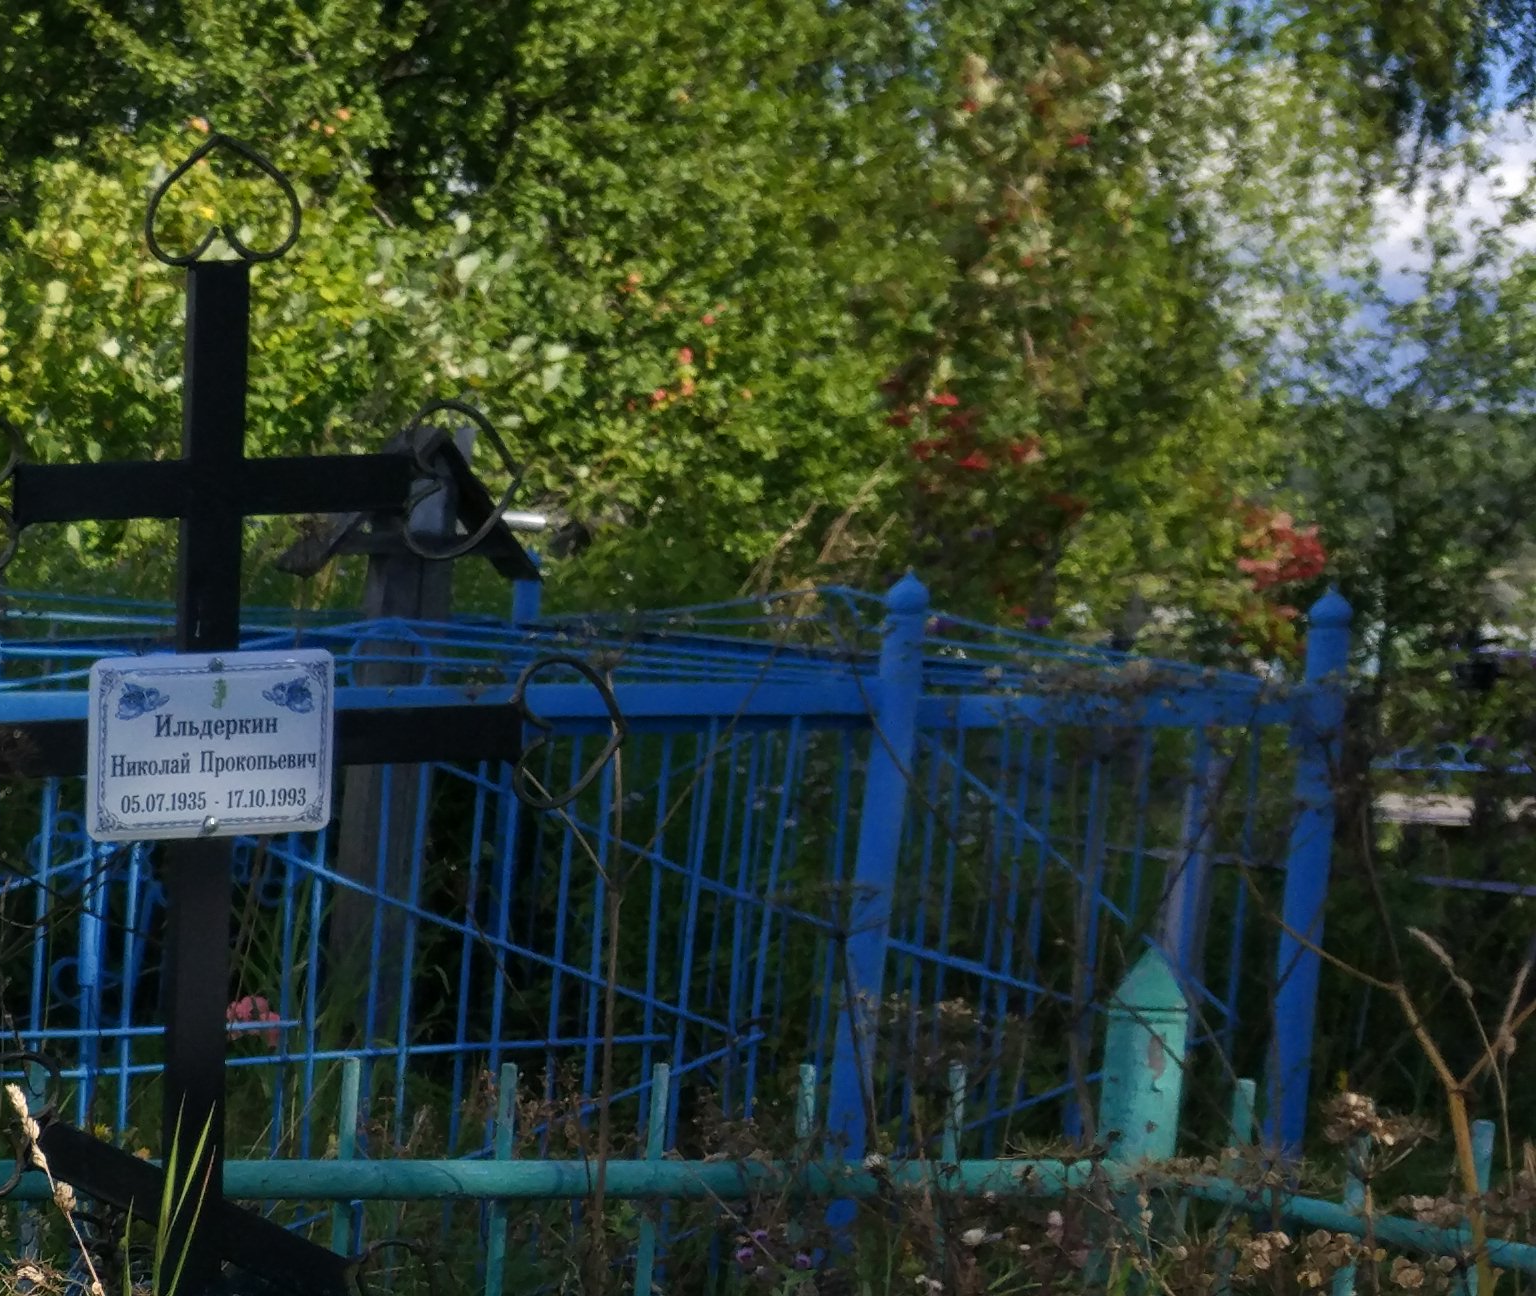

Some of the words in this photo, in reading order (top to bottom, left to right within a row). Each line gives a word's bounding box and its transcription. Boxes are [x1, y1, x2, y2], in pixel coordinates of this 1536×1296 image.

[154, 713, 279, 740] Ильдеркин
[110, 752, 191, 777] Николай
[199, 750, 317, 778] Прокопьевич
[121, 791, 207, 814] 05.07.1935
[227, 788, 307, 809] 17.10.1993
